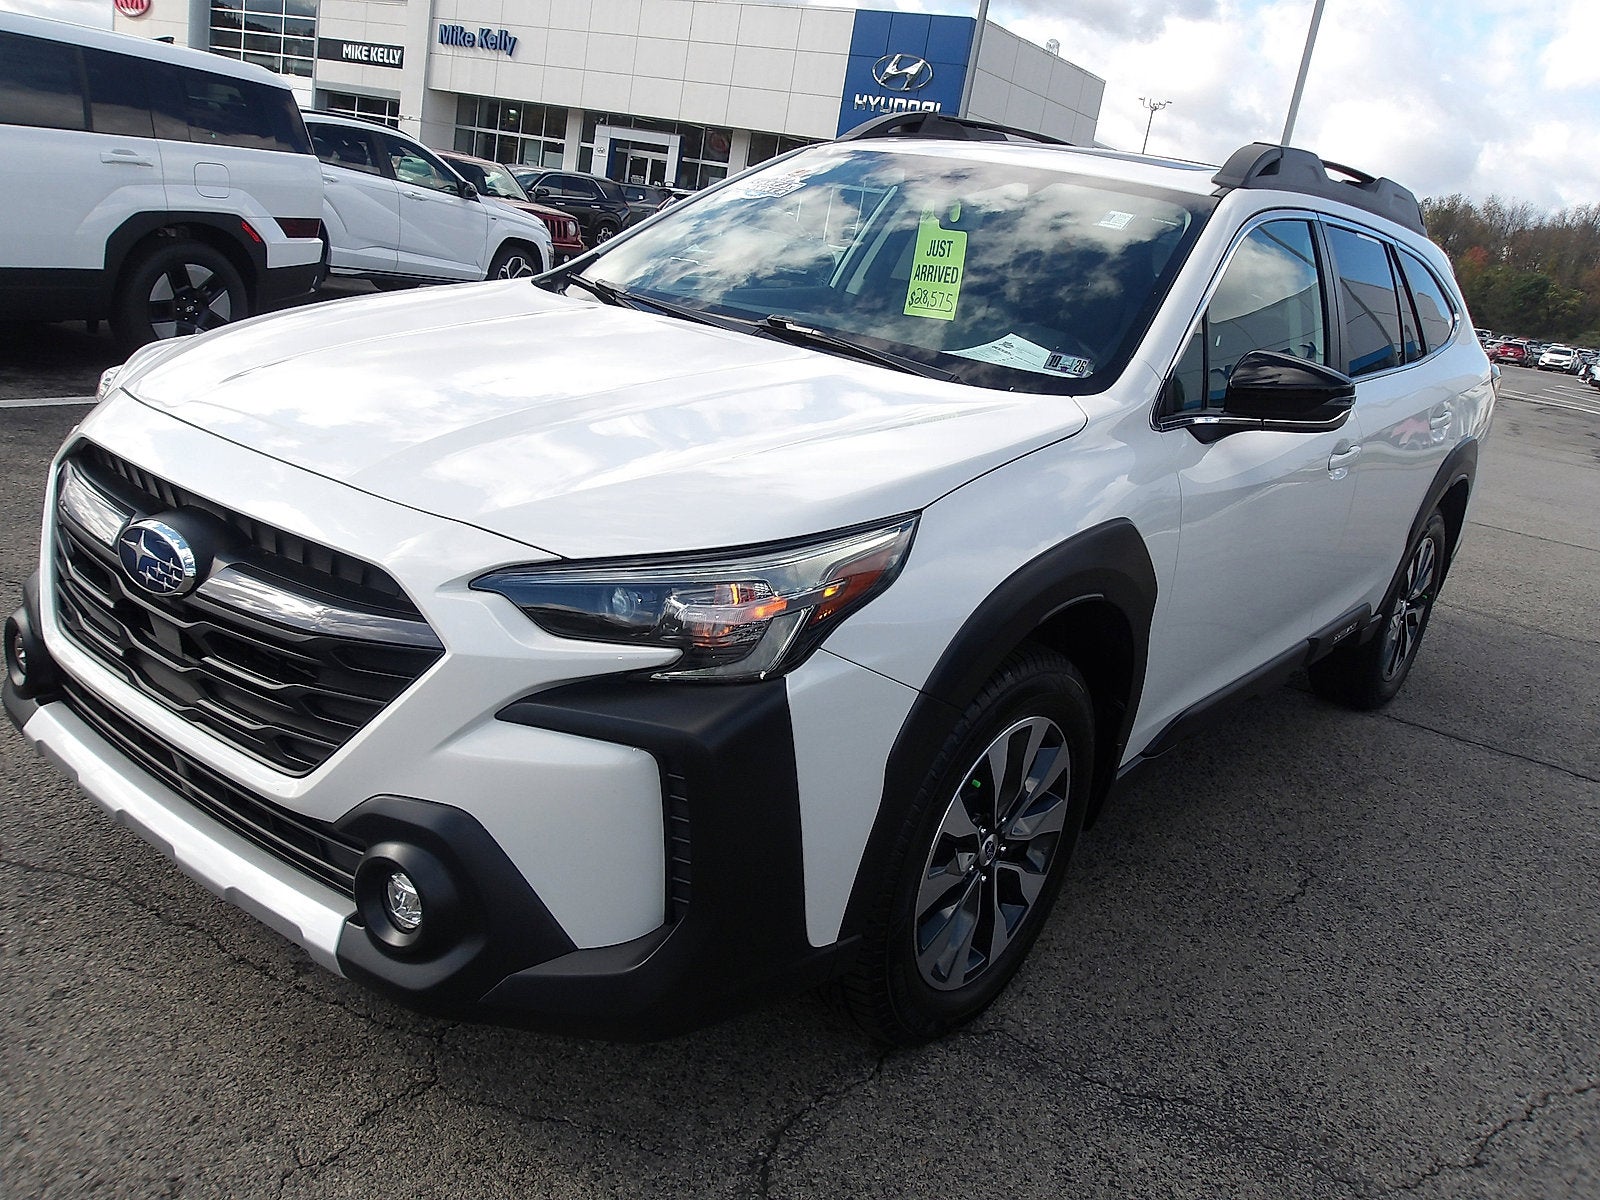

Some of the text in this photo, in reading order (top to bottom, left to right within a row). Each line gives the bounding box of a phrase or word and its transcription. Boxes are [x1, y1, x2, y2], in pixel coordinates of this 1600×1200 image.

[438, 24, 517, 56] Mike Kelly
[342, 43, 402, 64] MIKE KELLY
[854, 93, 942, 114] HYUNDAI
[926, 239, 953, 258] JUST
[913, 264, 959, 284] ARRIVED
[908, 288, 953, 311] $28,575
[1048, 354, 1062, 368] 10
[1073, 359, 1088, 373] 26
